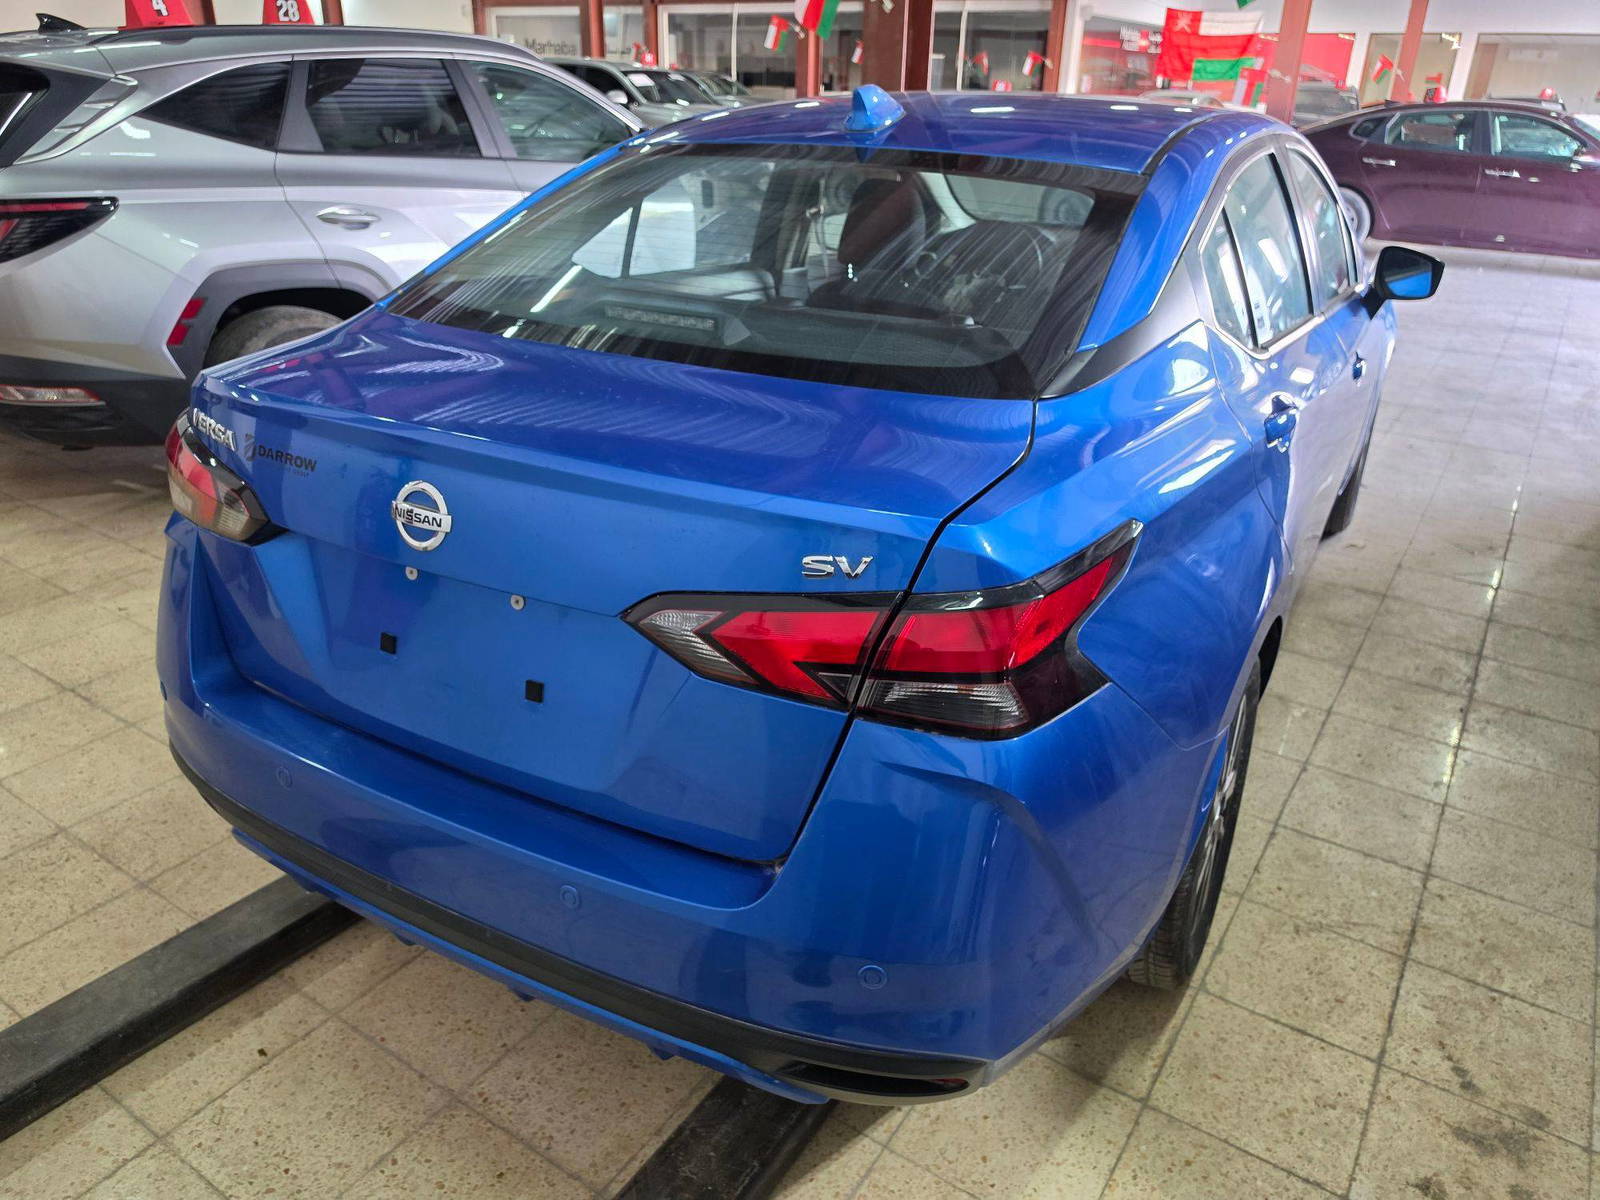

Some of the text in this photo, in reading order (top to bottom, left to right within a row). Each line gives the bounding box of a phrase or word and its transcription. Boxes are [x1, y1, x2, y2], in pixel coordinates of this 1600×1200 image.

[152, 0, 169, 17] 4
[277, 0, 300, 23] 28
[193, 407, 236, 452] VERSA
[258, 445, 317, 472] DARROW
[393, 503, 442, 528] NISSAN
[801, 554, 873, 579] SV
